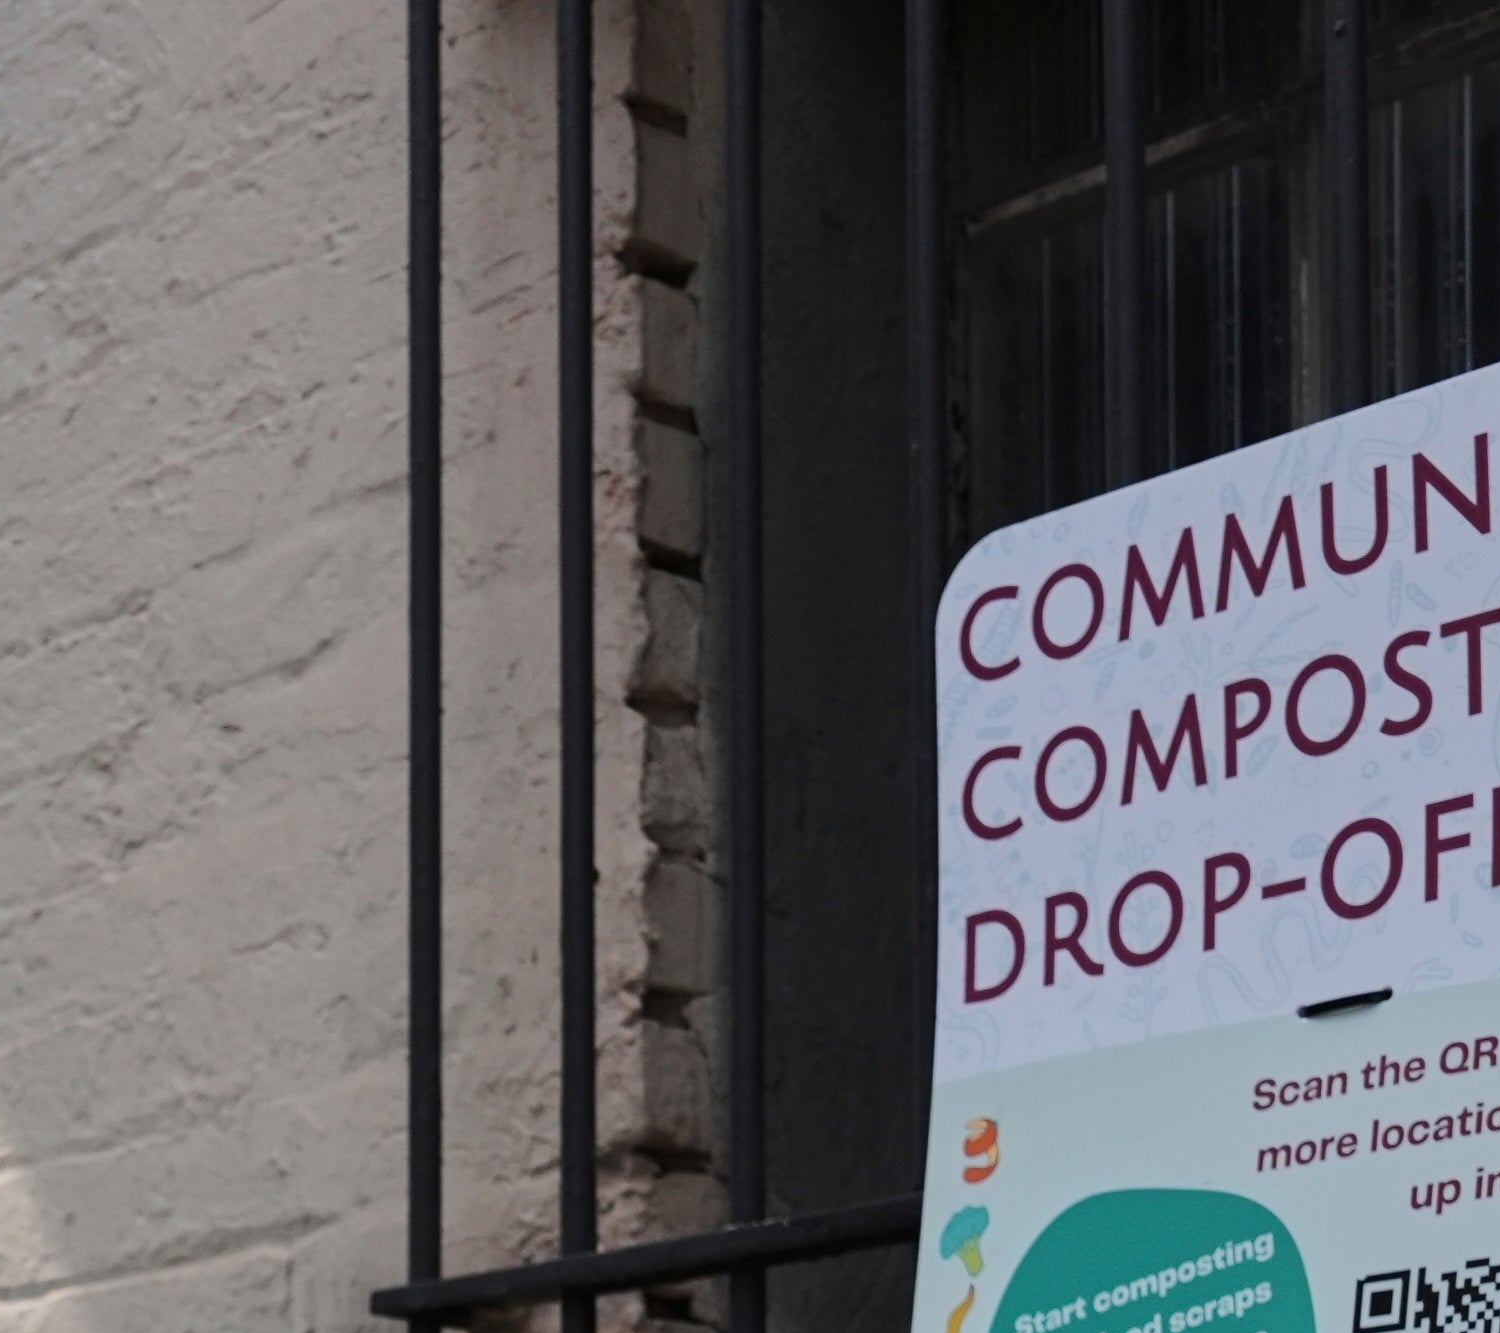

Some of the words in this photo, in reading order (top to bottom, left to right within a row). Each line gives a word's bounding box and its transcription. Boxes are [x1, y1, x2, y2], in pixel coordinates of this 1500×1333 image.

[1252, 1069, 1348, 1111] Scan
[1361, 1054, 1426, 1091] the
[1439, 1036, 1500, 1074] QR
[1256, 1131, 1358, 1172] more
[1410, 1178, 1462, 1214] up
[1093, 1231, 1274, 1313] composting
[1169, 1281, 1273, 1333] scraps
